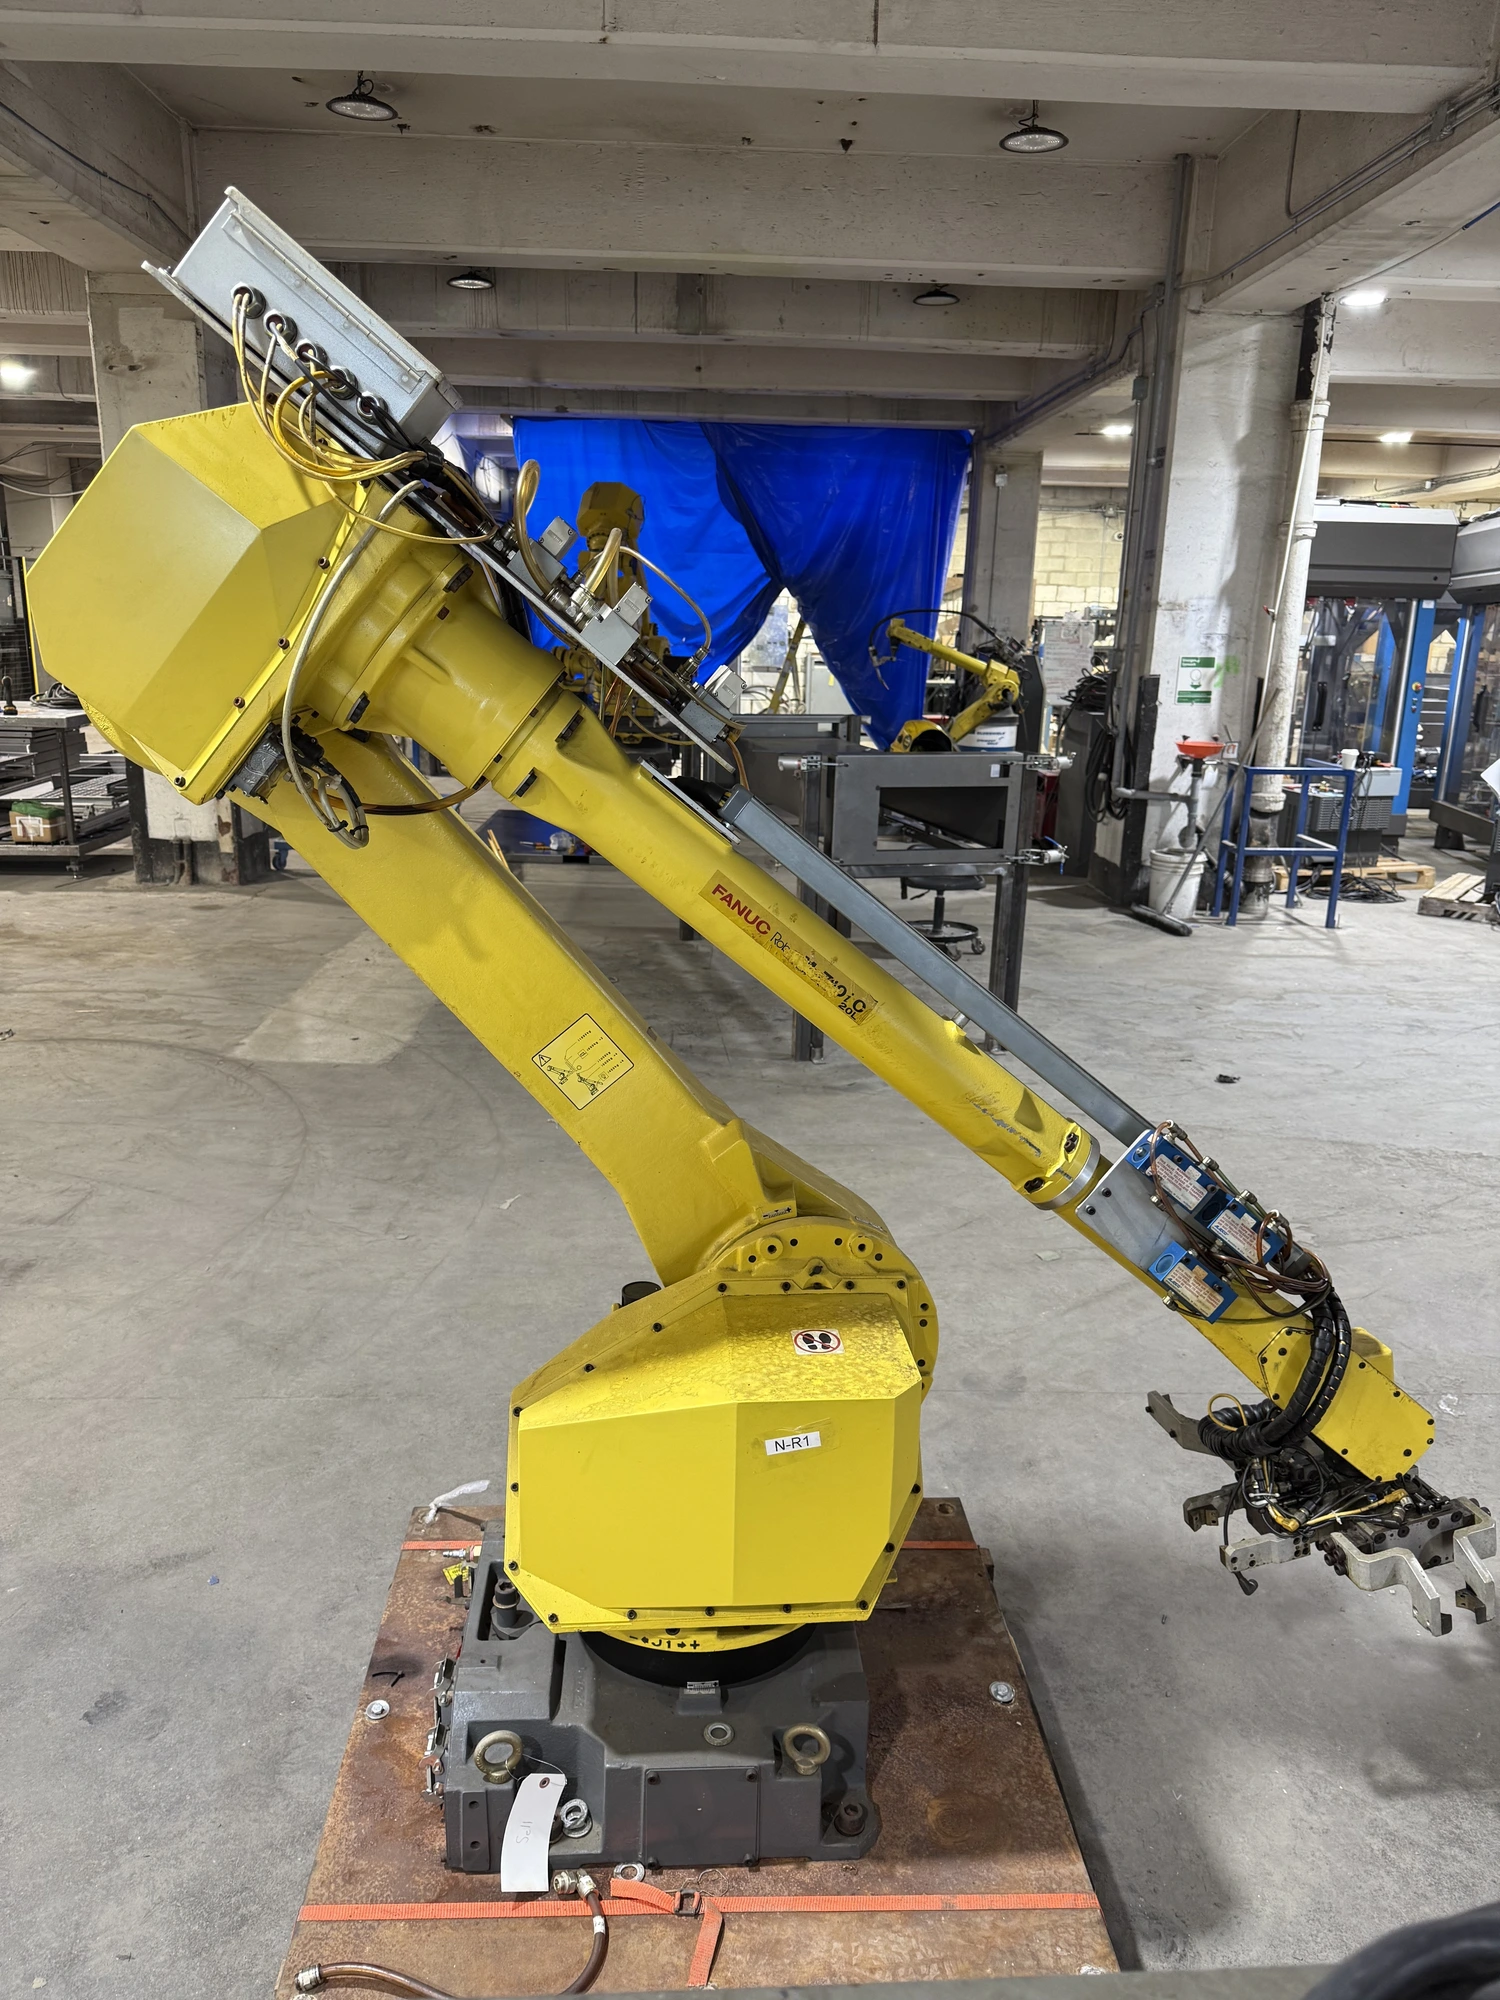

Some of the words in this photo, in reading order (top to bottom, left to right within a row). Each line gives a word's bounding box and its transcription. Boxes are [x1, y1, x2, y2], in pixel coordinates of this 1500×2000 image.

[712, 884, 771, 935] FANUC
[838, 1002, 857, 1021] 20L
[774, 1435, 810, 1452] N-R1
[651, 1639, 672, 1649] J1
[515, 1821, 533, 1844] Sell
